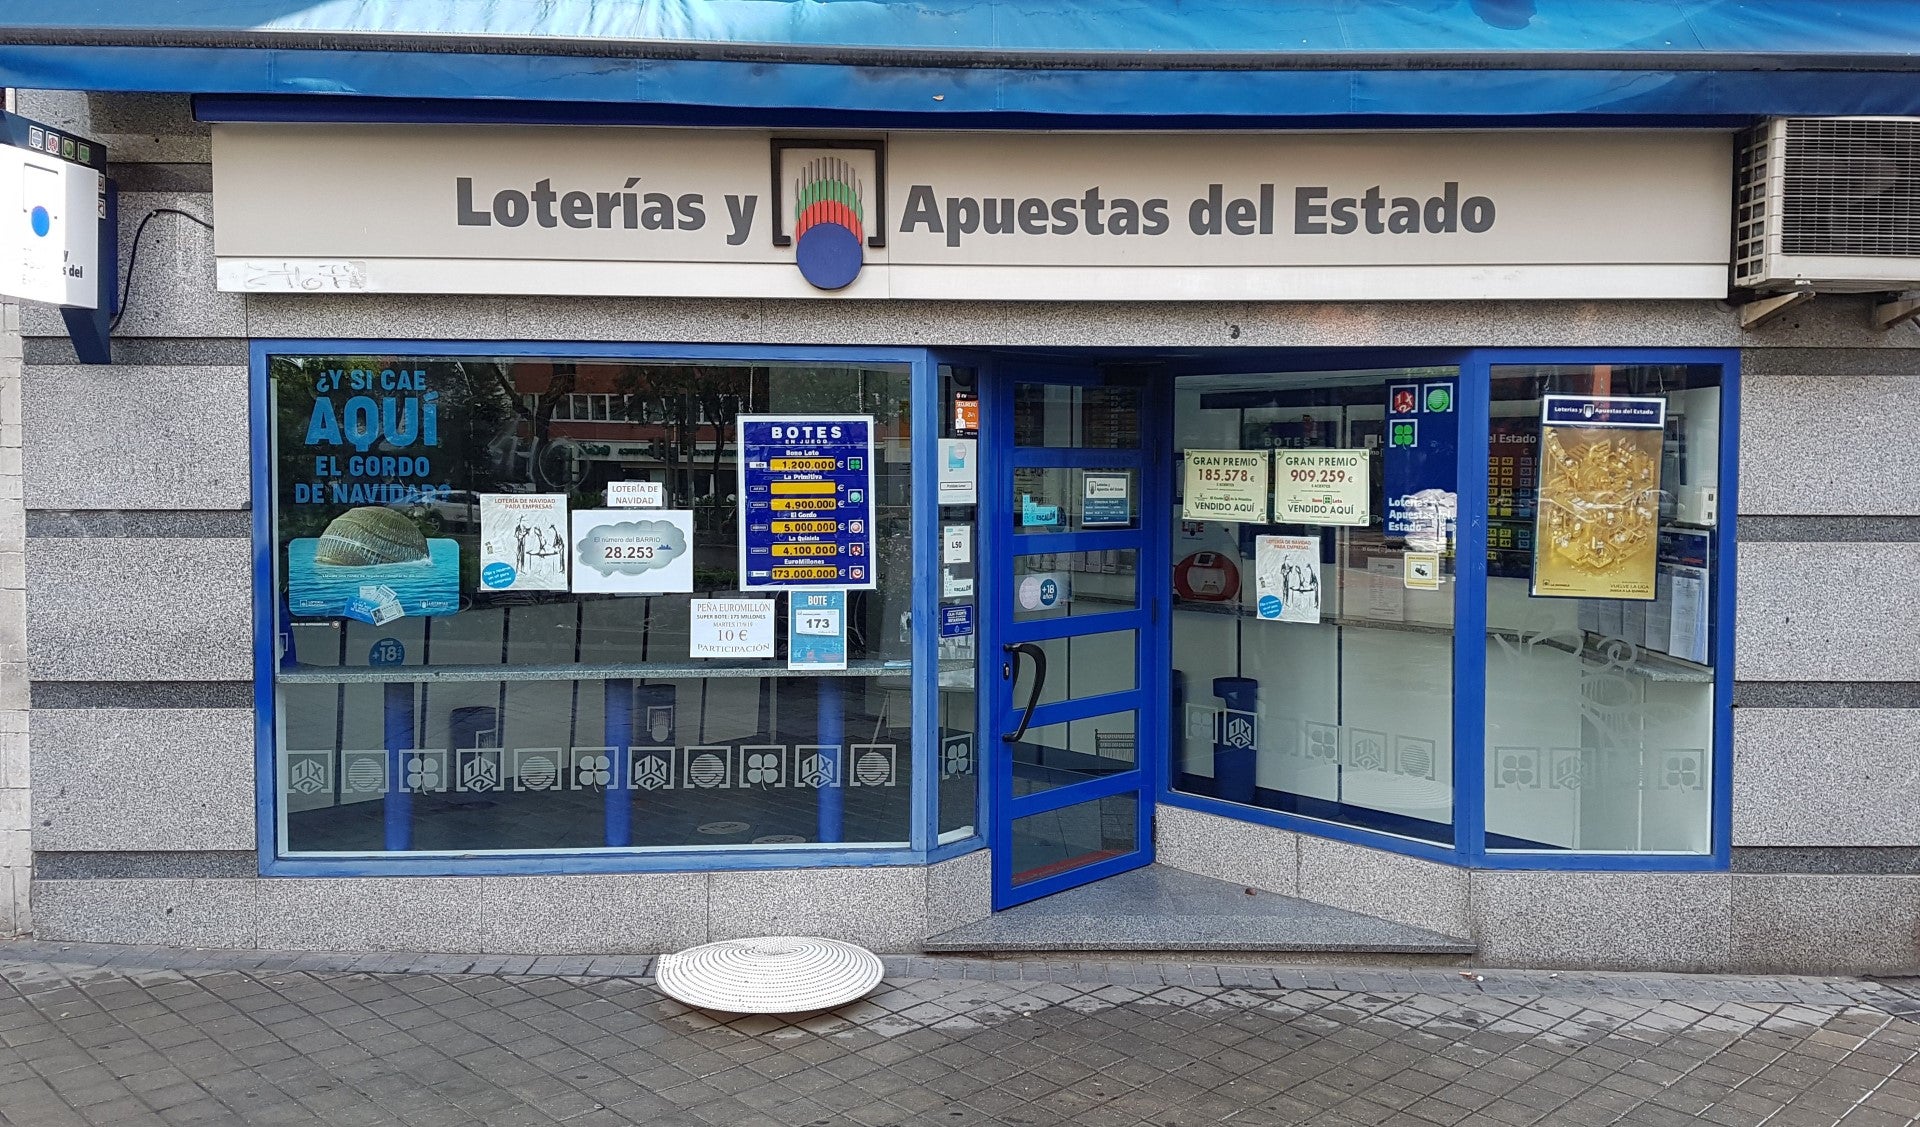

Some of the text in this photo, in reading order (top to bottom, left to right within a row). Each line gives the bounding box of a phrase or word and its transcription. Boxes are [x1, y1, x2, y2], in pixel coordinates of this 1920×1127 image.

[456, 176, 1496, 248] Loterías y Apuestas del Estado
[68, 264, 83, 279] del
[316, 369, 427, 392] ¿Y SI CAE
[1595, 407, 1622, 415] Apuestas
[304, 390, 439, 452] AQUÍ
[771, 426, 842, 439] BOTES
[1264, 437, 1311, 447] BOTES
[1499, 433, 1537, 444] Estado
[315, 455, 430, 478] EL GORDO
[782, 460, 835, 470] 1.200.000
[1193, 456, 1258, 467] GRAN PREMIO
[1285, 456, 1358, 467] GRAN PREMIO
[1198, 468, 1255, 483] 185.578 €
[1290, 469, 1353, 483] 909.259 €
[295, 483, 324, 504] DE
[612, 484, 659, 493] LOTERÍA DE
[615, 496, 654, 505] NAVIDAD
[784, 500, 834, 510] 4.900.000
[1194, 501, 1255, 512] VENDIDO AQUÍ
[1287, 504, 1354, 514] VENDIDO AQUÍ
[784, 523, 835, 532] 5.000.000
[1388, 521, 1422, 532] Estado
[601, 535, 624, 543] número
[624, 535, 635, 543] del
[604, 546, 654, 559] 28.253
[783, 546, 836, 555] 4.100.000
[772, 569, 836, 579] 173.000.000
[1041, 584, 1055, 594] +18
[807, 595, 828, 606] BOTE
[697, 601, 771, 612] PEÑA EUROMILLÓN
[806, 618, 830, 629] 173
[718, 629, 748, 641] 10 €
[697, 643, 770, 653] PARTICIPACIÓN
[372, 646, 397, 662] +18
